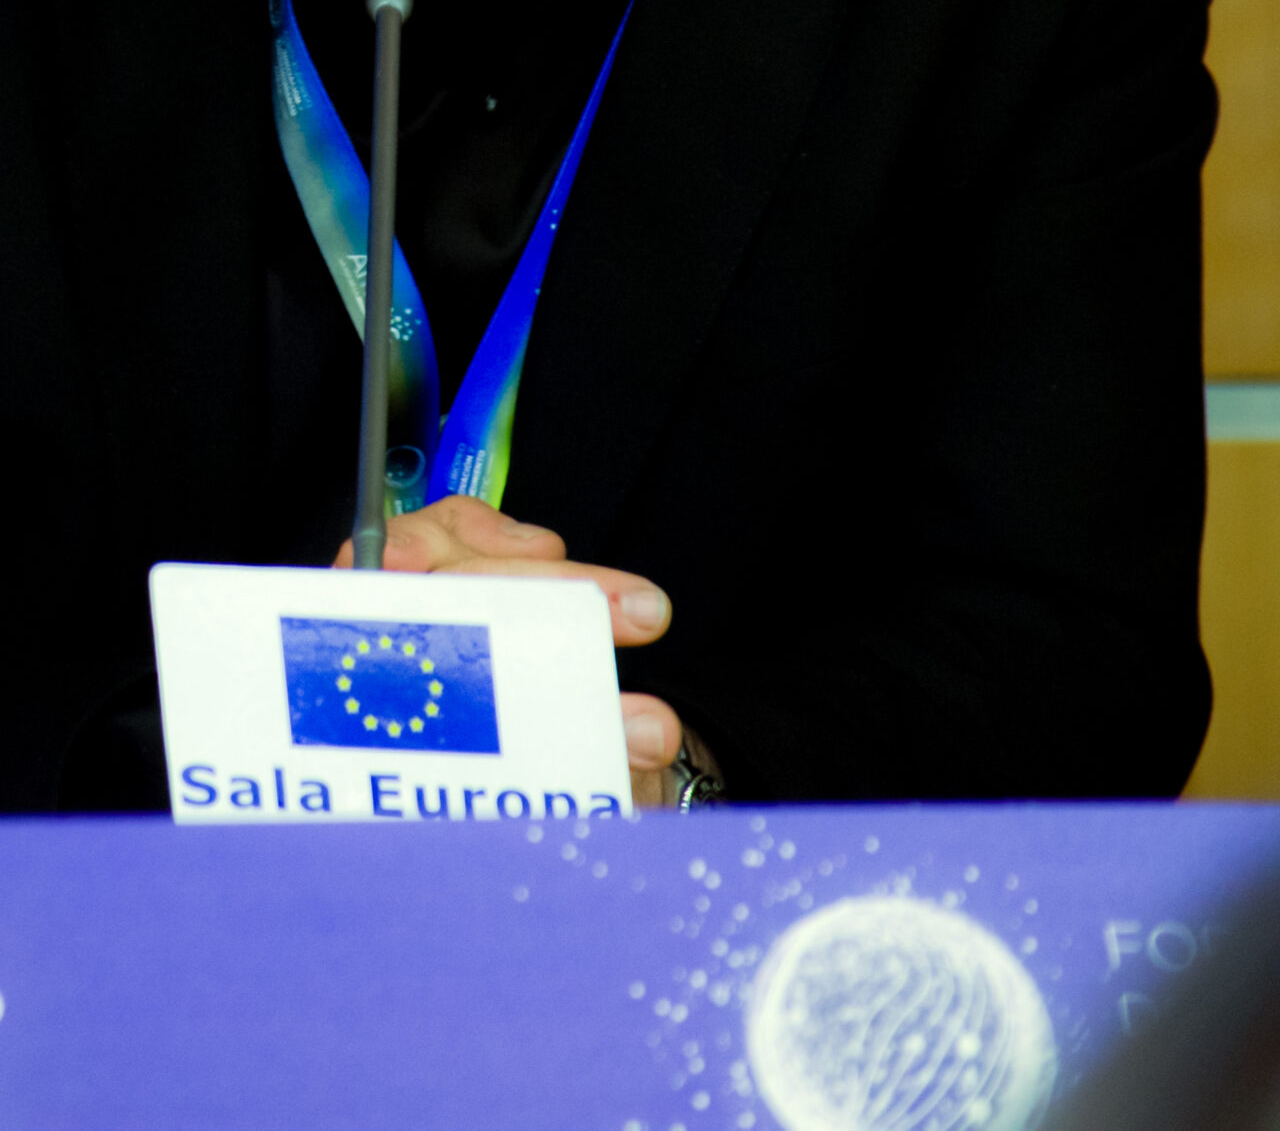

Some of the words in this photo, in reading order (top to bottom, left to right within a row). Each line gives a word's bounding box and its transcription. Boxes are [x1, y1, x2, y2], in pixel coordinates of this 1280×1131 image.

[180, 764, 334, 813] Sala
[369, 773, 624, 821] Europa
[1103, 919, 1214, 973] FO
